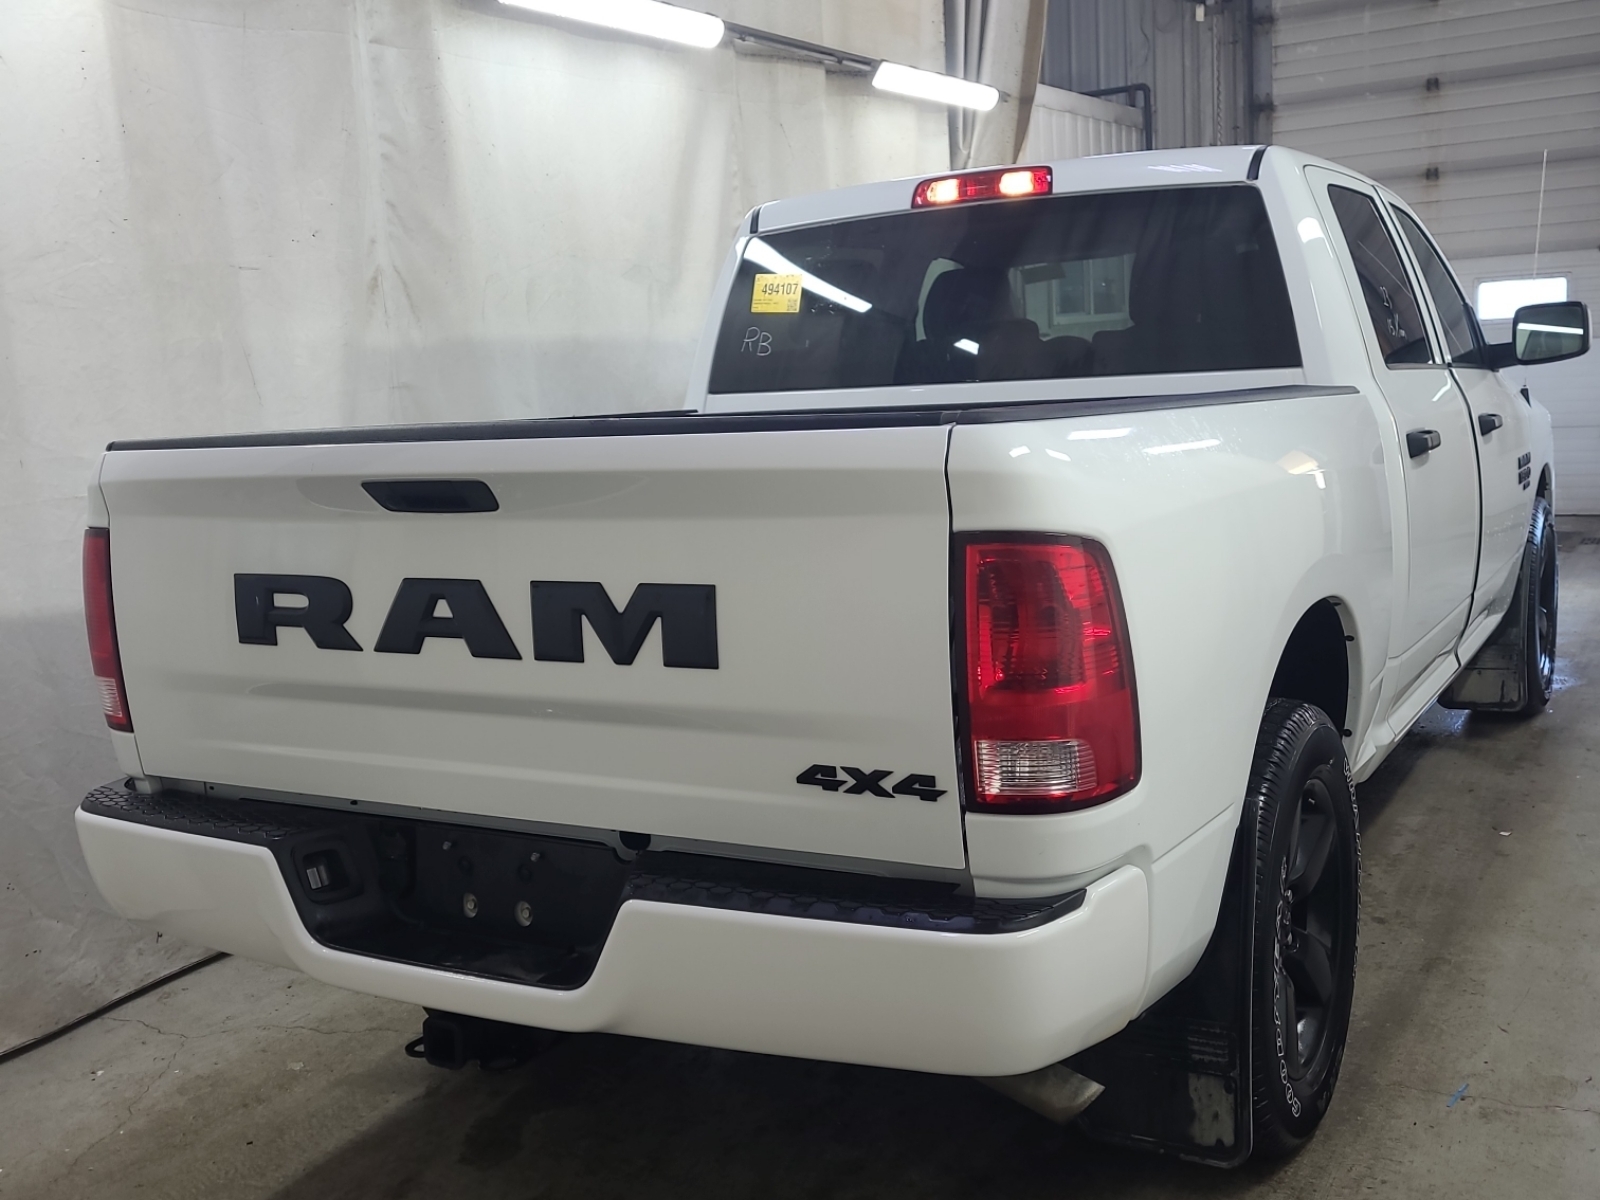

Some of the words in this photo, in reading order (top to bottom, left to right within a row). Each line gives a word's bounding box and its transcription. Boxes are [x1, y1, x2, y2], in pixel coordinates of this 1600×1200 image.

[761, 283, 799, 295] 494107
[741, 326, 772, 356] RB
[233, 573, 720, 669] RAM
[796, 763, 949, 802] 4X4
